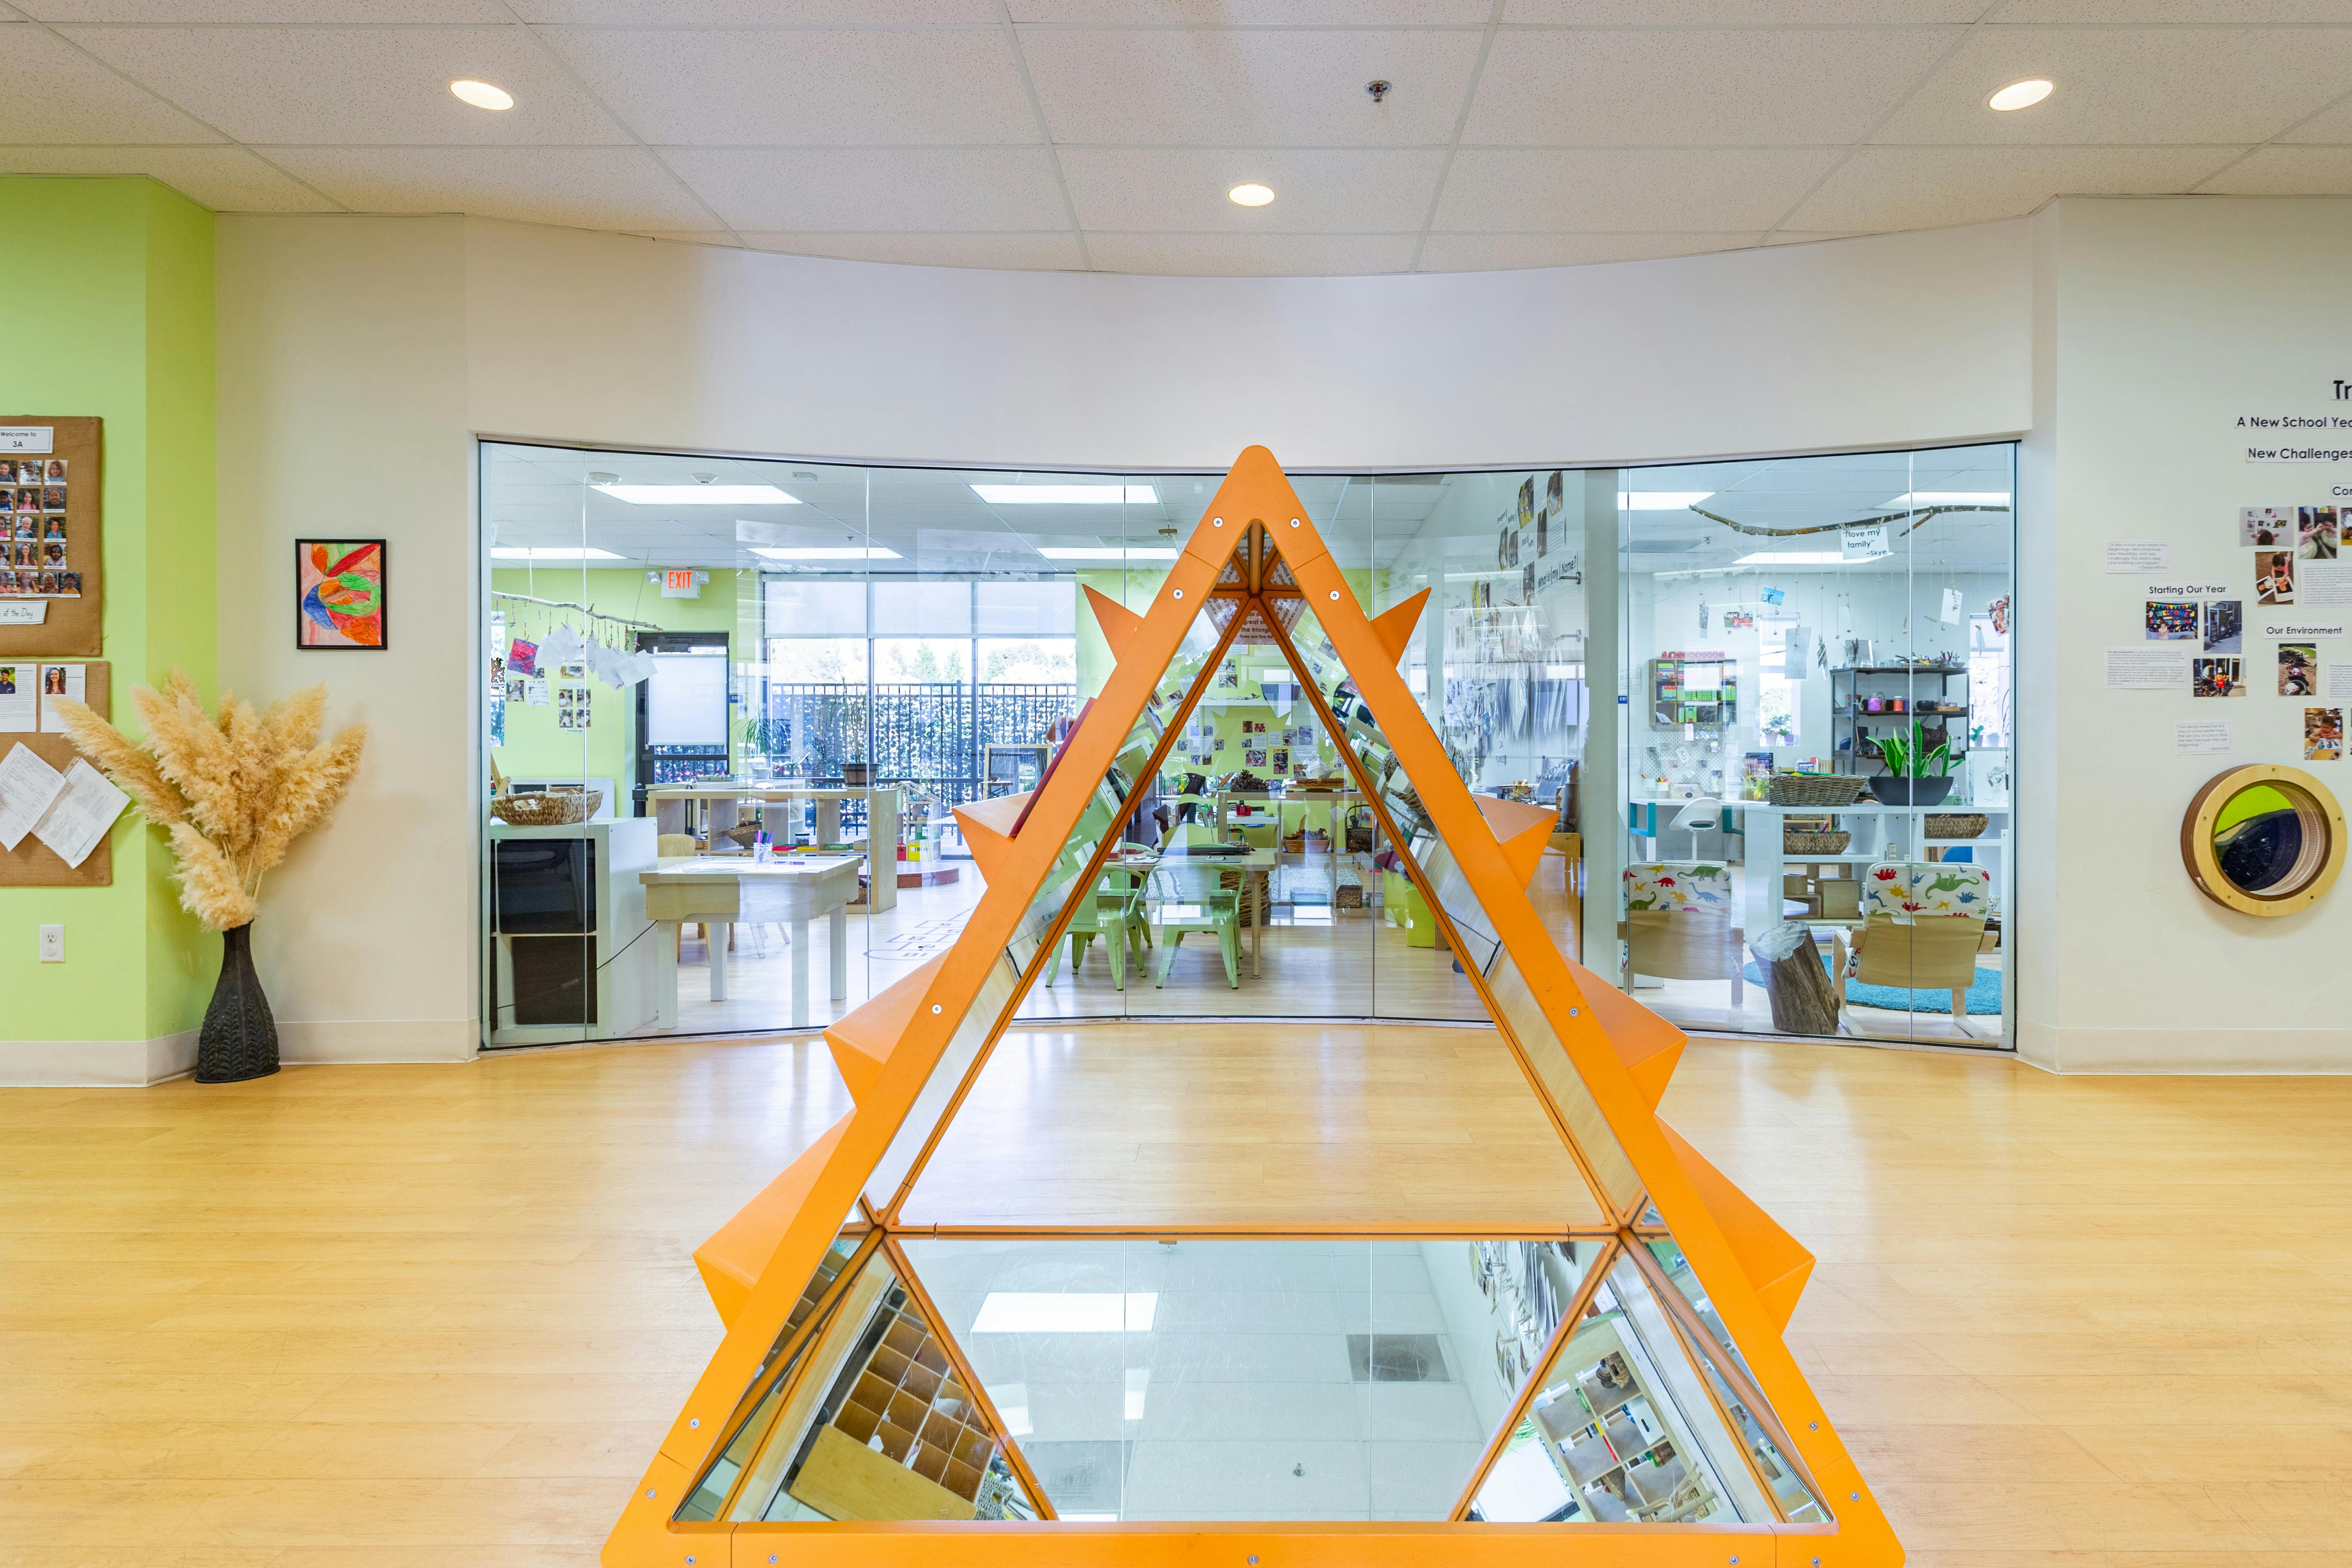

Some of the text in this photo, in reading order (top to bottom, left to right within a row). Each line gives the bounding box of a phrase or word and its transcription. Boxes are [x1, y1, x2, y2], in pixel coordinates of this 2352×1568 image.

[2237, 417, 2245, 427] A
[2251, 417, 2280, 427] New
[2282, 417, 2326, 427] School
[2249, 448, 2277, 458] New
[1538, 556, 1577, 588] What is my Name?
[668, 571, 692, 589] EXIT
[2149, 586, 2183, 595] Starting
[21, 608, 34, 619] Day
